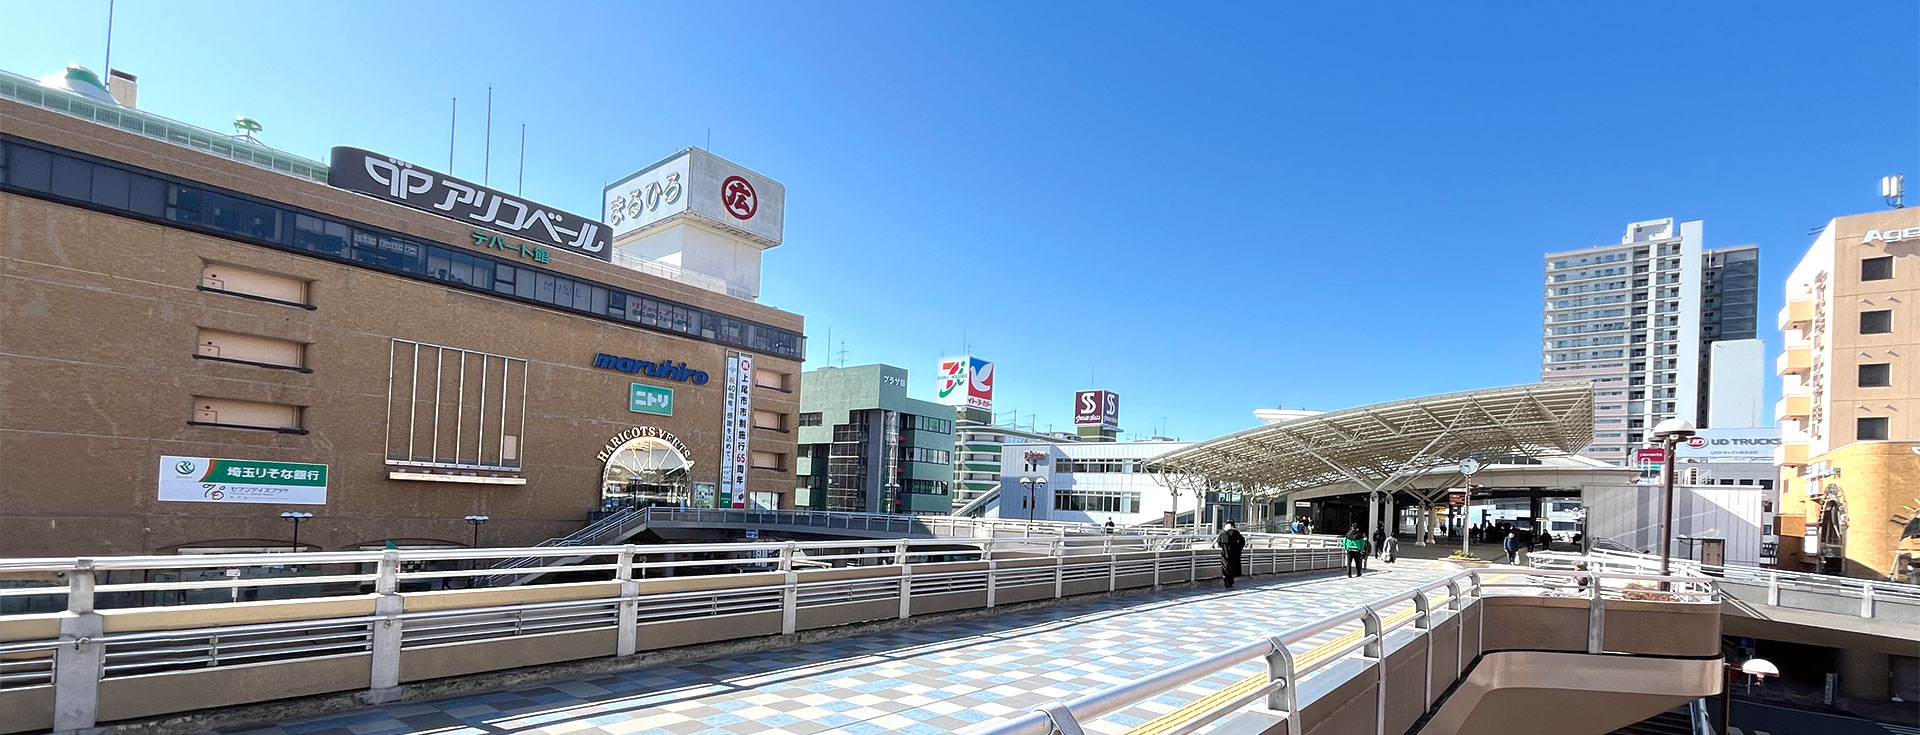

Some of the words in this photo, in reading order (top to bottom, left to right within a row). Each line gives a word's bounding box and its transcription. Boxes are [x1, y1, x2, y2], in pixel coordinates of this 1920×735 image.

[611, 171, 681, 226] まるひろ
[434, 179, 604, 252] アリコベール
[593, 353, 709, 385] maruhiro
[635, 390, 669, 409] ニトリ
[597, 426, 656, 463] HARICOTS
[658, 428, 691, 459] VERTS
[1711, 438, 1730, 446] UD
[1731, 438, 1782, 446] TRUCKS
[227, 466, 319, 482] 埼玉りそな銀行
